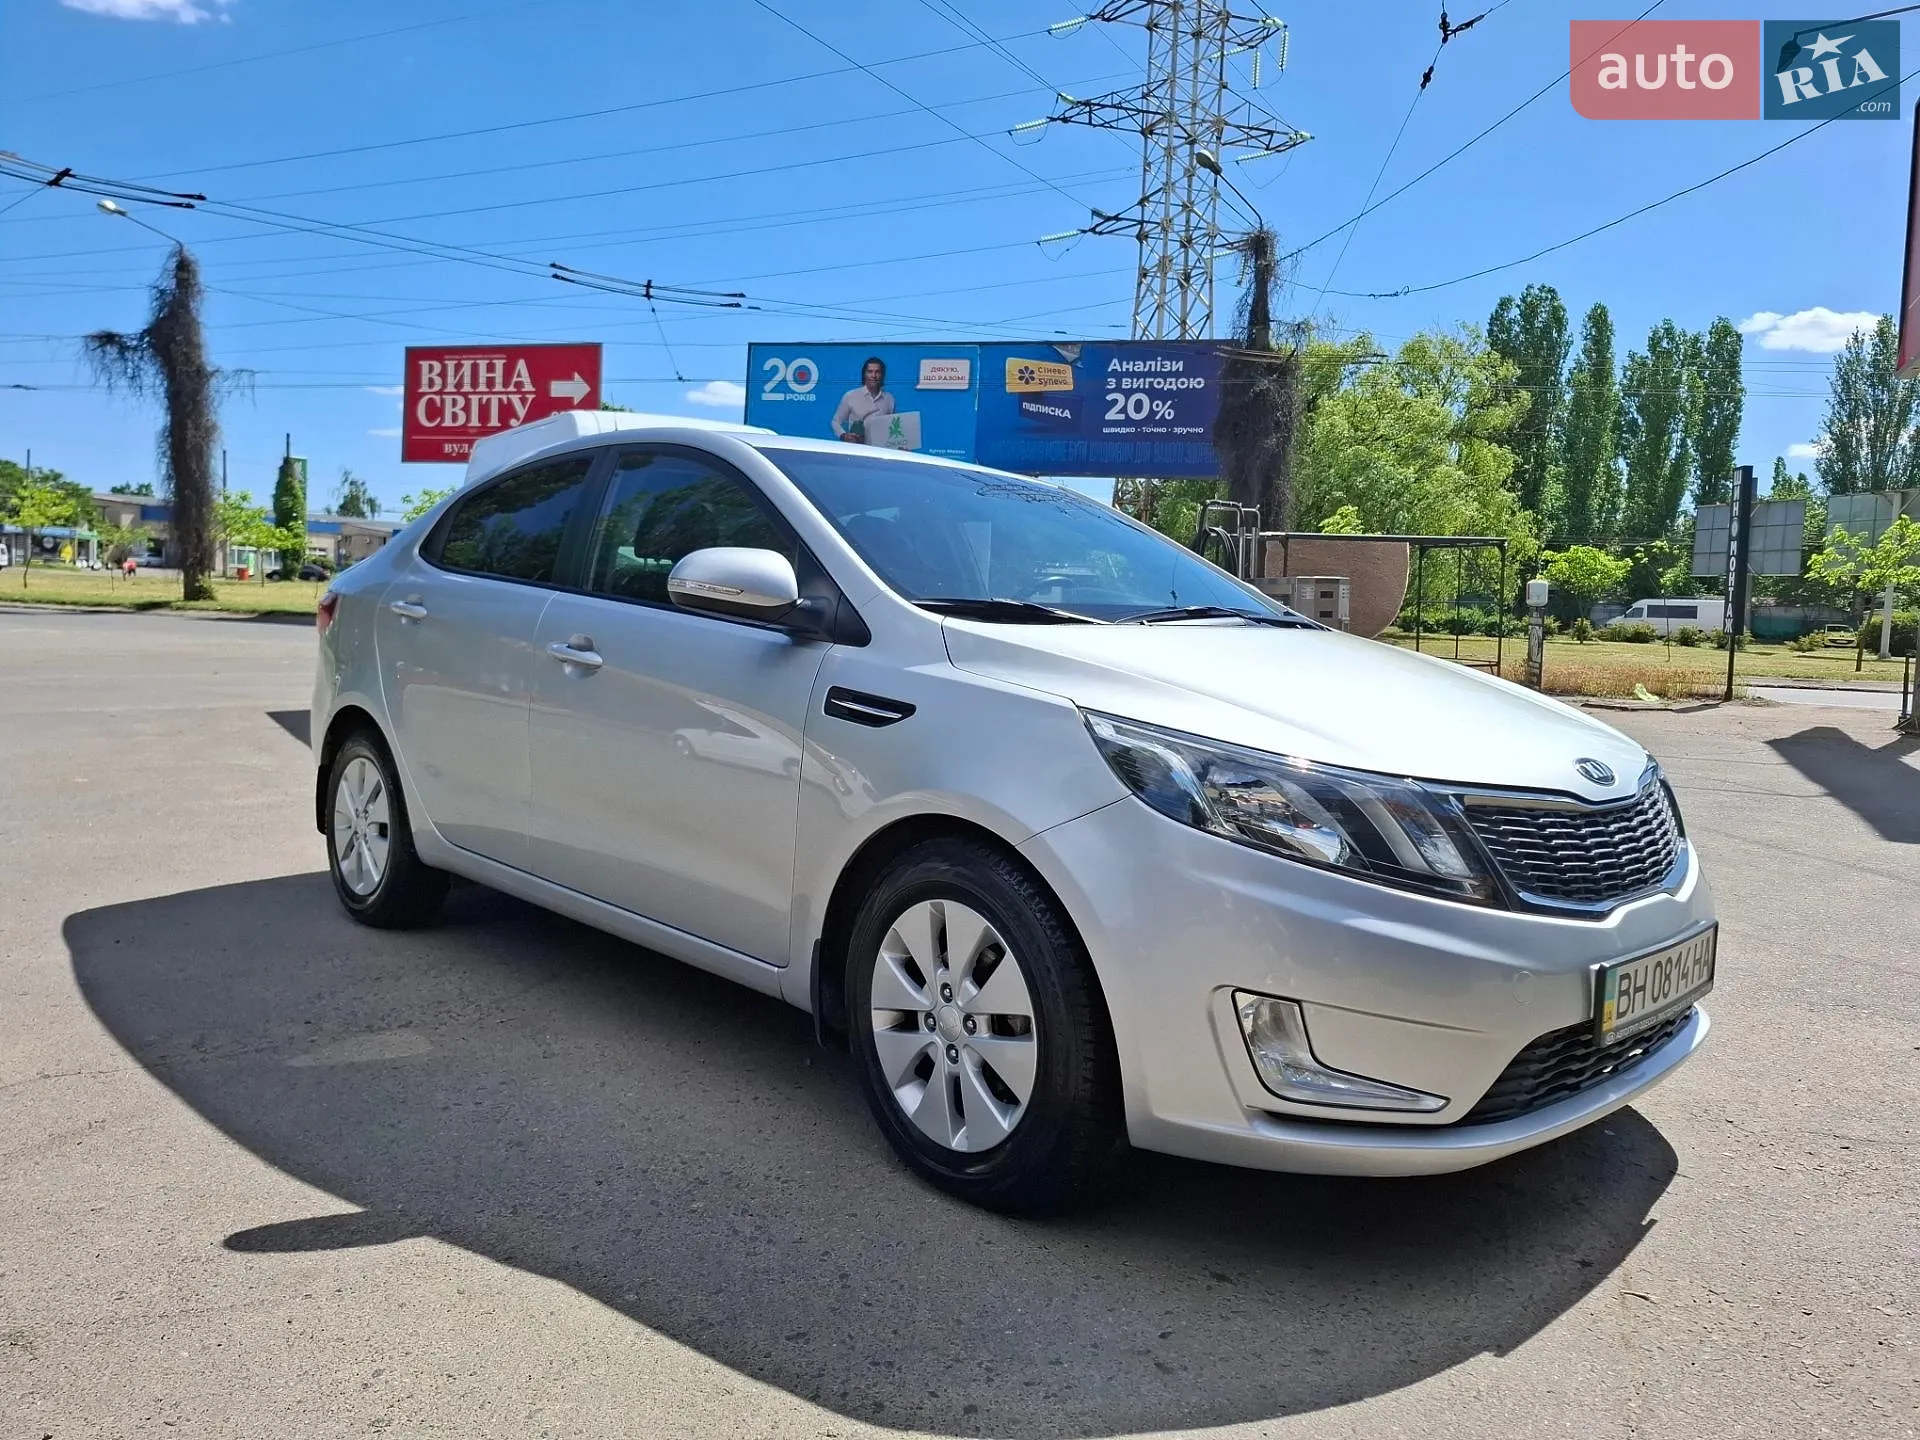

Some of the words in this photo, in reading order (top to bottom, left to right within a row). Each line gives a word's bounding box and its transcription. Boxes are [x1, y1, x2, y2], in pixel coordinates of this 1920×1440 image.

[1108, 357, 1183, 373] Аналізи
[417, 358, 536, 393] ВИНА
[761, 357, 819, 401] 20
[1106, 378, 1116, 389] з
[1122, 377, 1205, 391] вигодою
[785, 393, 816, 401] РОКІВ
[416, 394, 536, 427] СВІТУ
[1022, 402, 1072, 419] ПІДПИСКА
[1173, 427, 1204, 435] зручно
[1724, 469, 1742, 634] ШИНОМОНТАЖ
